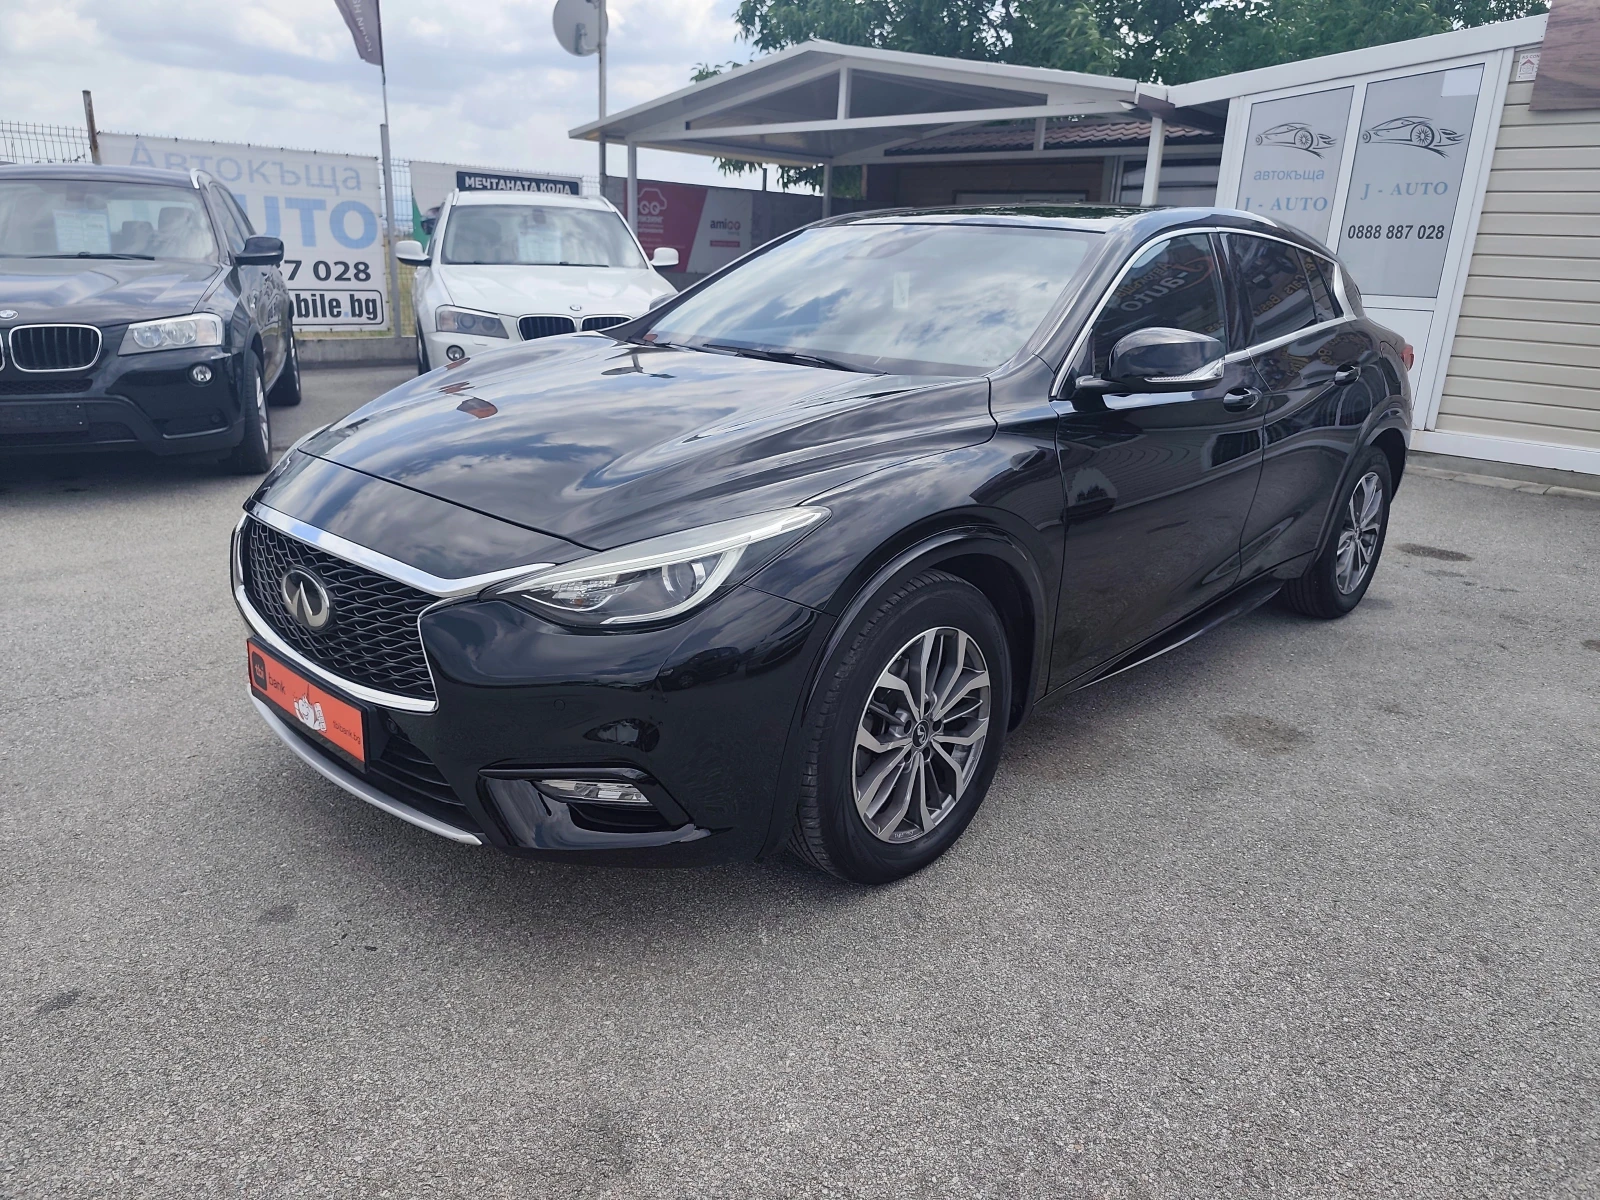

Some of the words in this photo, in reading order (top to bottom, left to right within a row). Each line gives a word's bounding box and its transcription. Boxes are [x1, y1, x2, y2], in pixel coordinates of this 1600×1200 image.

[129, 140, 362, 196] Автокъща
[1253, 169, 1325, 183] автокъща
[464, 176, 538, 192] МЕЧТАНАТА
[539, 183, 572, 196] КОЛА
[1360, 183, 1371, 200] J
[1390, 181, 1449, 196] AUTO
[1269, 196, 1328, 212] AUTO
[233, 194, 378, 250] UTO
[1347, 224, 1382, 240] 0888
[1385, 224, 1414, 240] 887
[1417, 224, 1445, 240] 028
[312, 260, 372, 283] 028
[292, 293, 379, 321] bile.bg
[268, 671, 287, 696] bank
